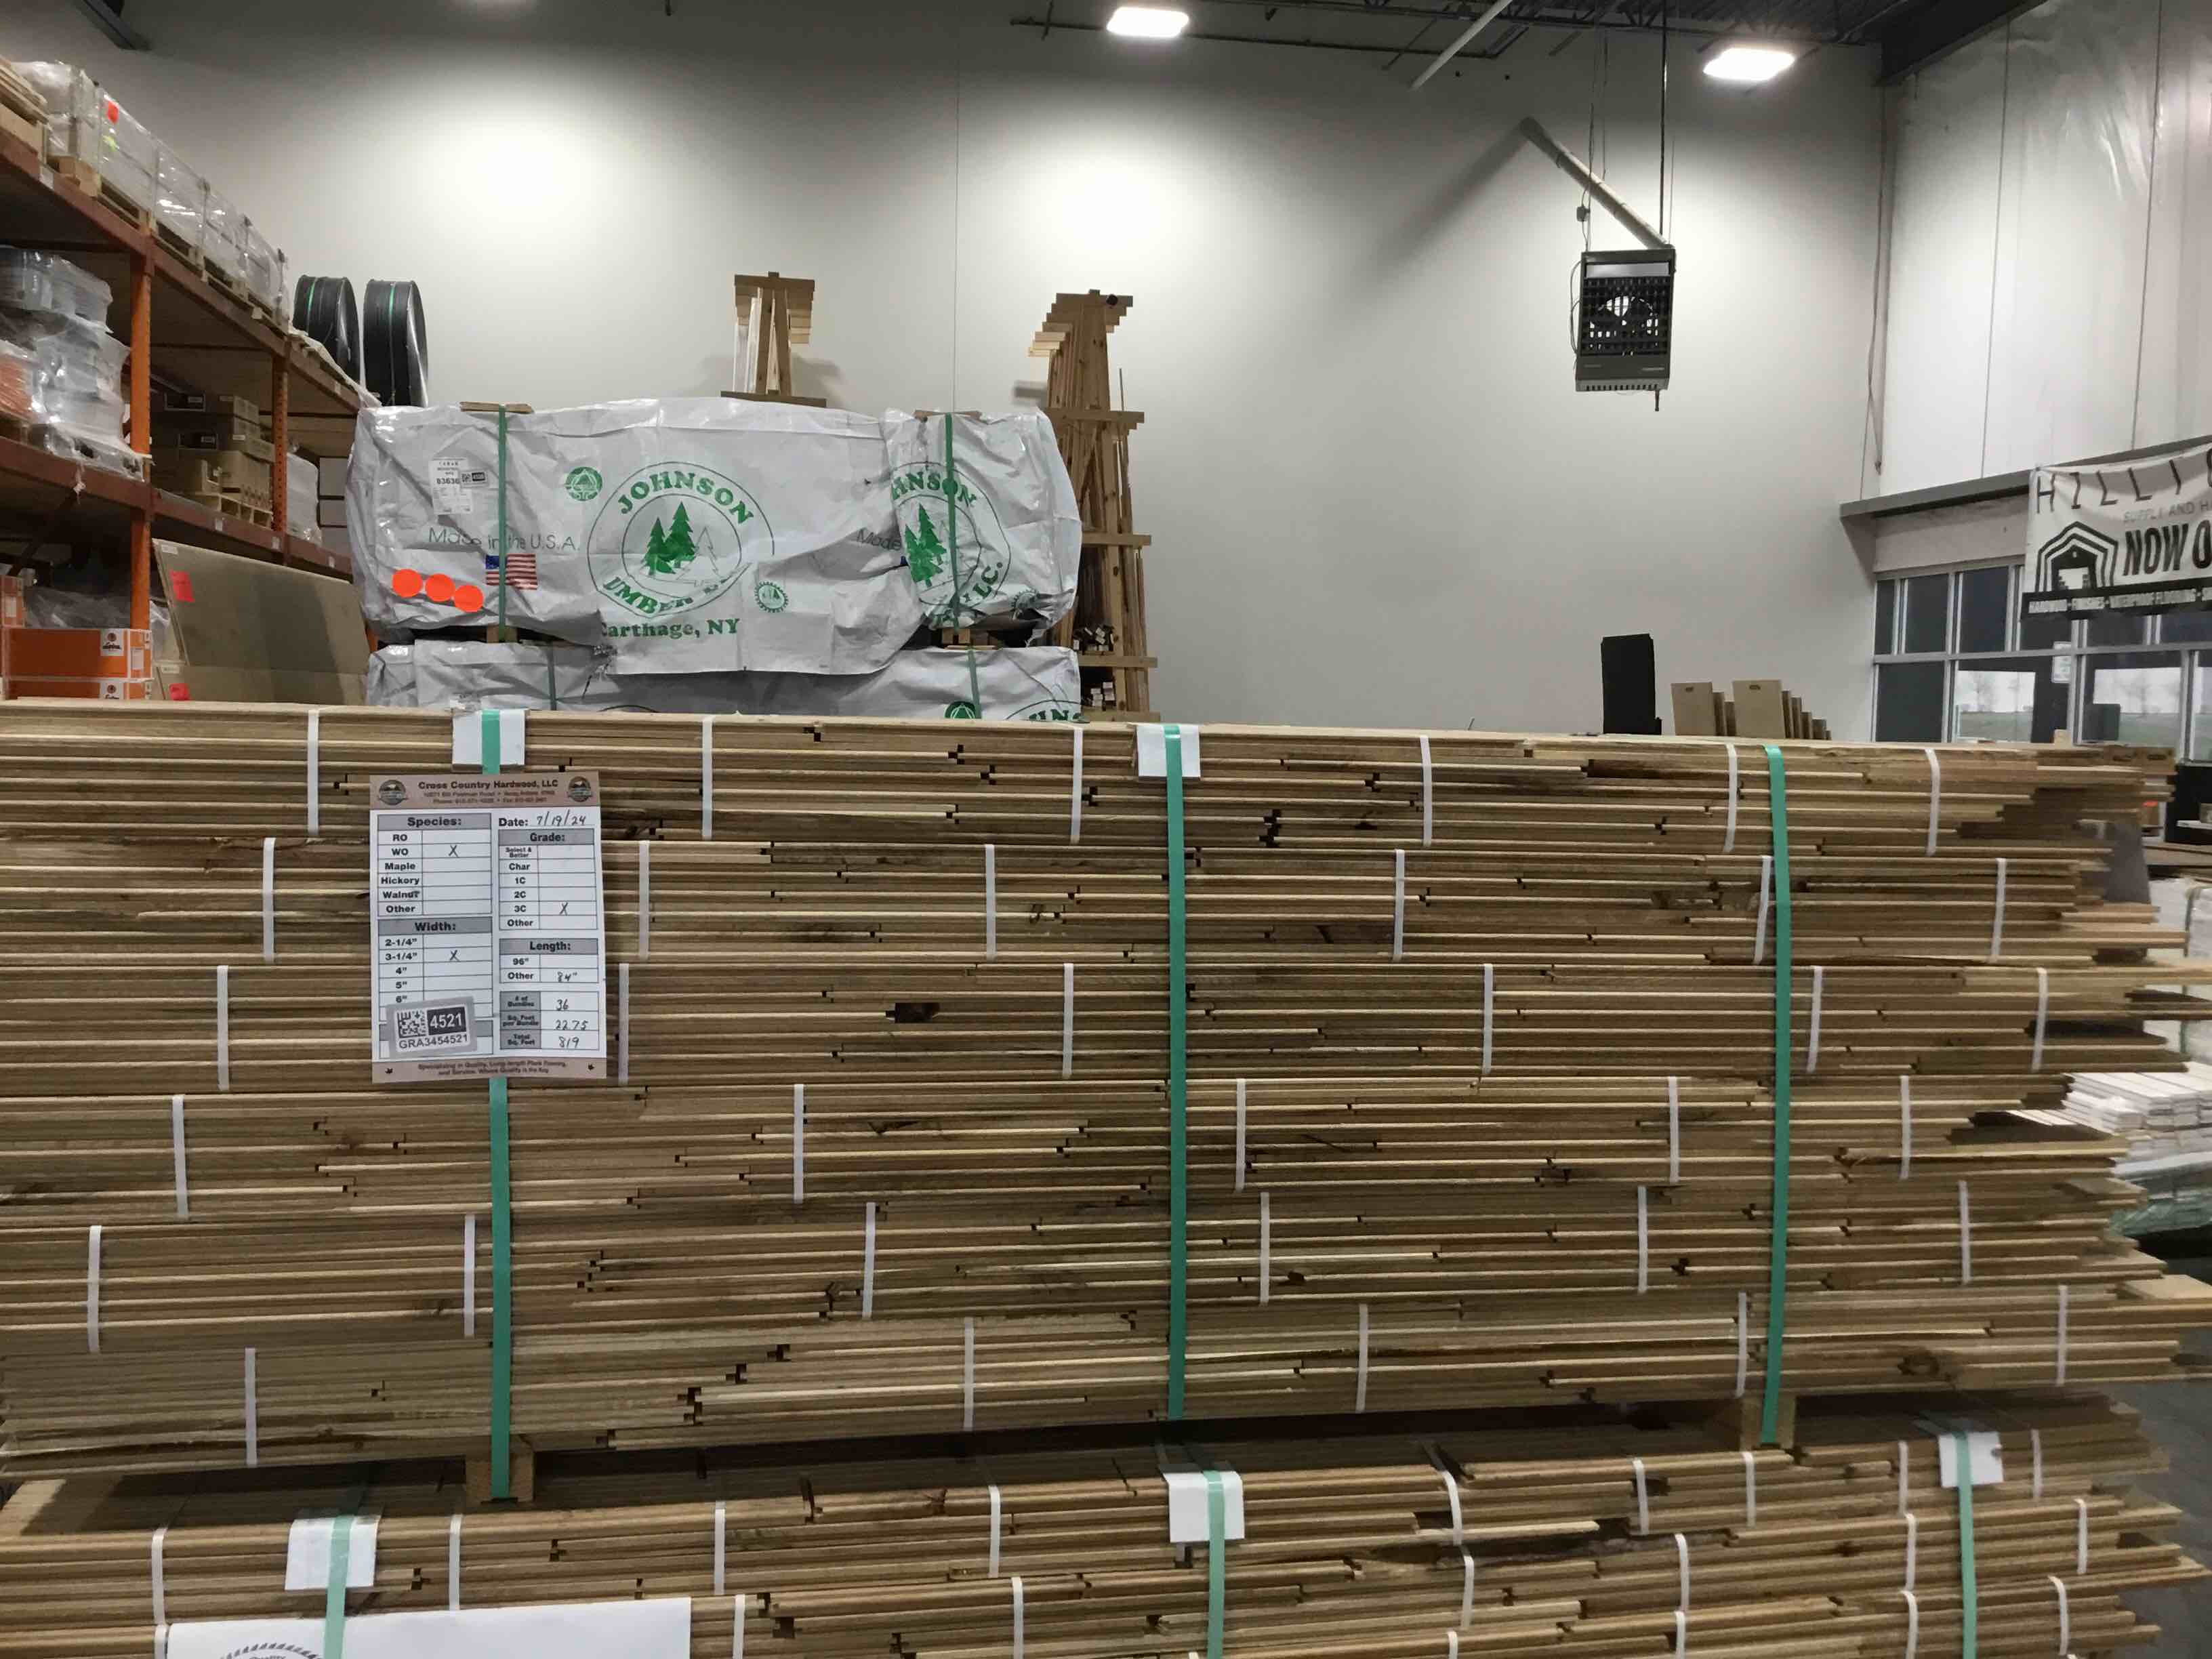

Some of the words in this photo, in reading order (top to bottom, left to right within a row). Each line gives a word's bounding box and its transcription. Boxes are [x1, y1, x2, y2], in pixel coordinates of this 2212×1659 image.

[618, 471, 754, 524] JOHNSON
[2123, 523, 2190, 575] NOW
[707, 618, 740, 634] NY
[418, 781, 447, 790] Cross
[451, 781, 491, 790] Country
[541, 779, 559, 787] LLC
[407, 817, 461, 827] Species:
[499, 818, 529, 826] Date:
[537, 809, 586, 827] 7/19/24
[530, 833, 565, 842] Grade:
[391, 848, 409, 856] WO
[449, 845, 459, 857] X
[384, 863, 416, 871] Maple
[381, 876, 419, 885] Hickory
[383, 890, 419, 899] Walnut
[386, 905, 415, 913] Other
[559, 902, 569, 916] X
[415, 922, 457, 931] Width:
[529, 941, 571, 952] Length:
[449, 949, 460, 962] X
[556, 999, 569, 1010] 36
[430, 1012, 462, 1028] 4521
[398, 1034, 468, 1049] GRA3454521
[558, 1036, 579, 1048] 819
